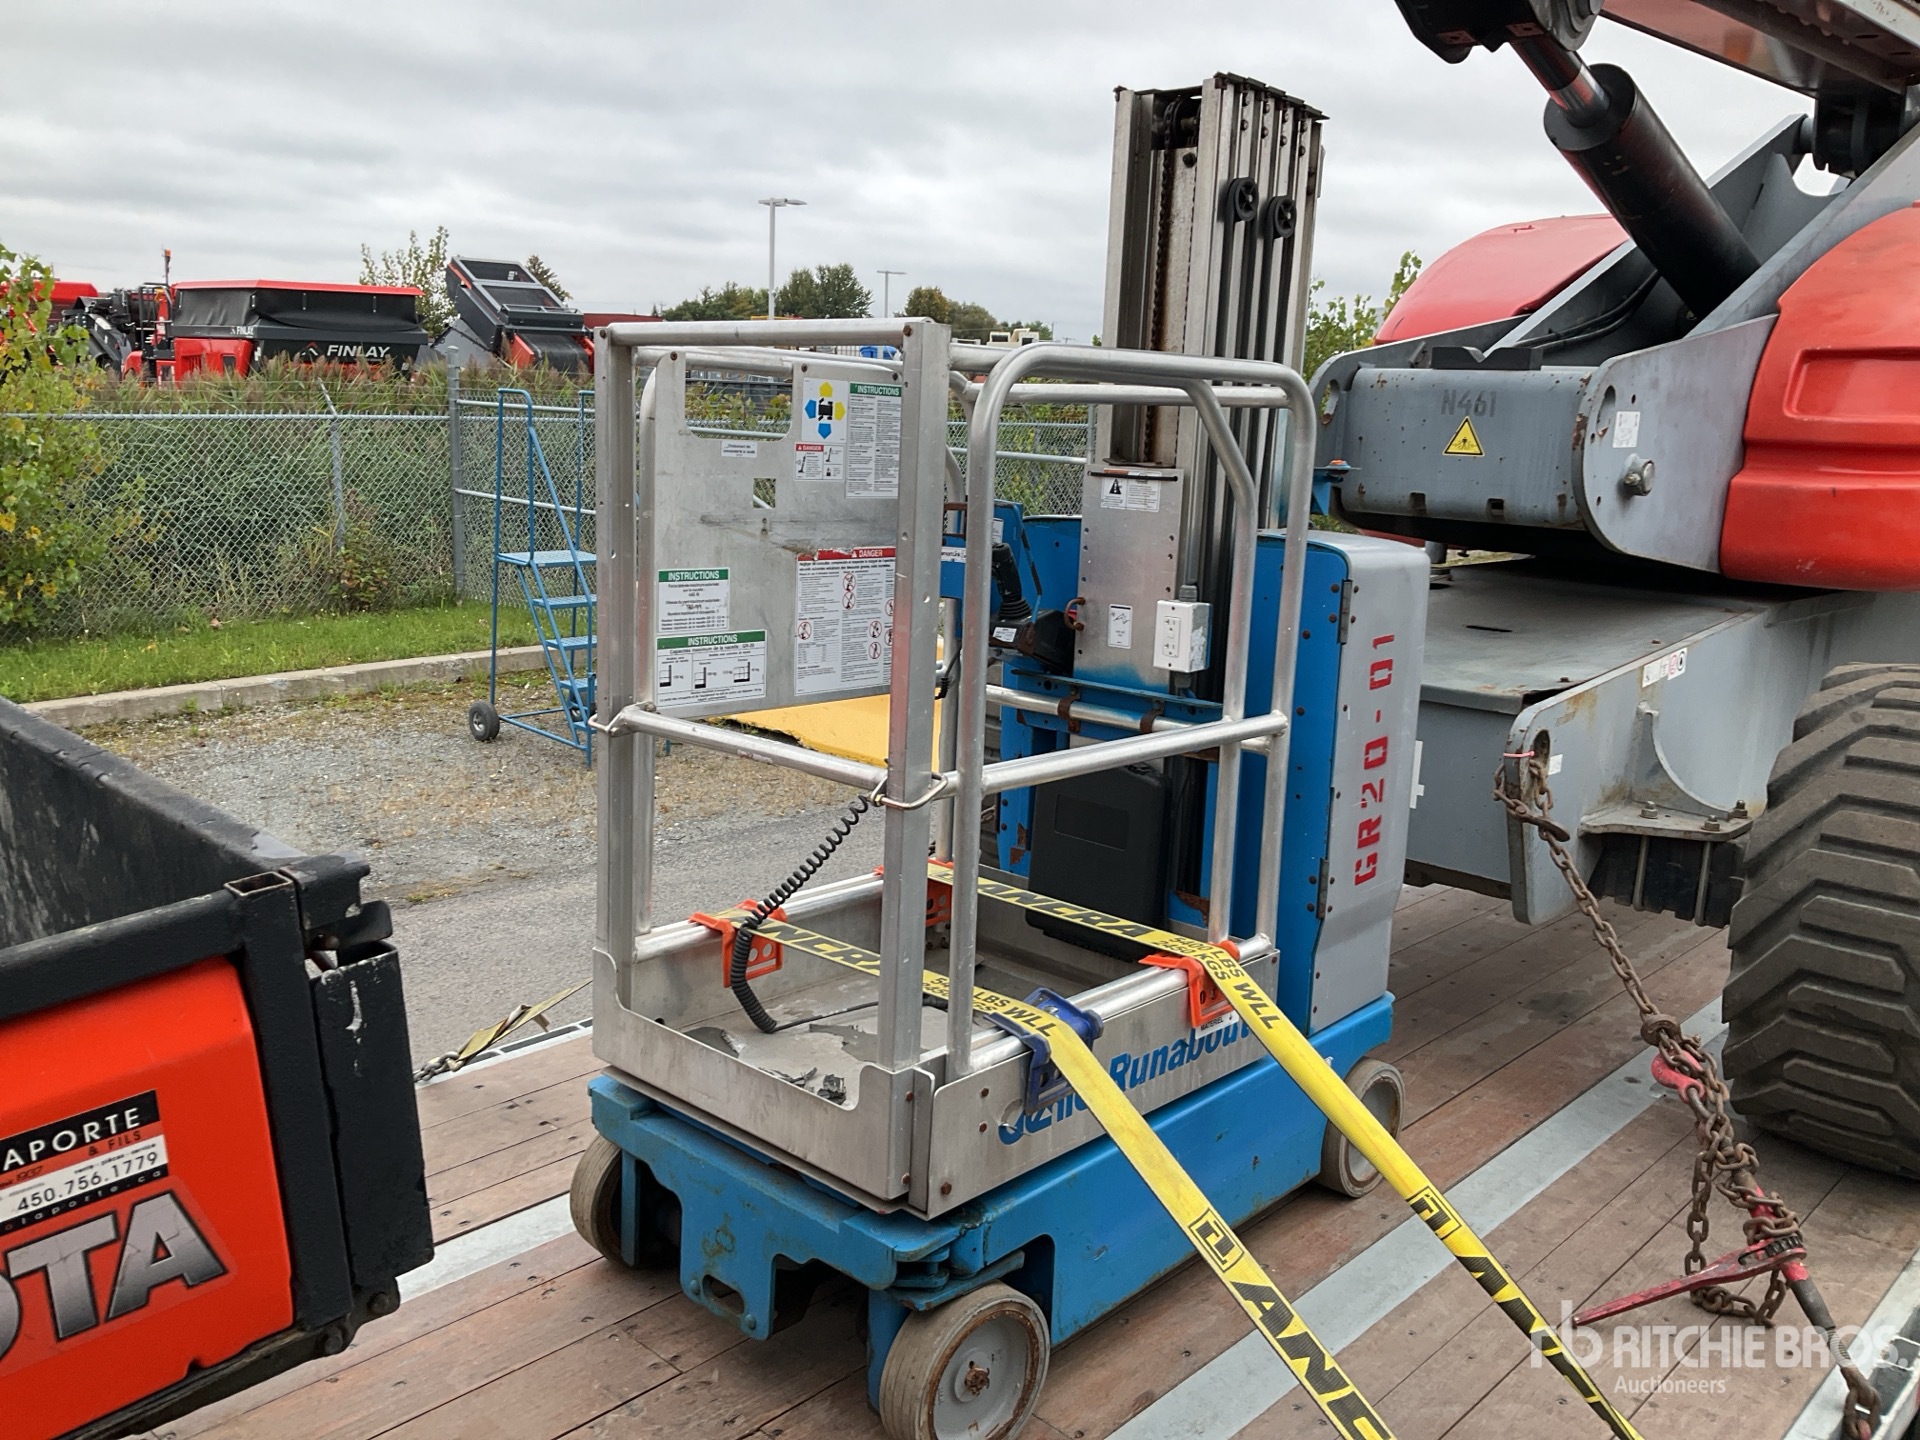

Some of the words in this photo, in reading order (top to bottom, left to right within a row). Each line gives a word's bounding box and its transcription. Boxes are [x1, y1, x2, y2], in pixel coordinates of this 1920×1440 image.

[327, 345, 390, 358] FINLAY
[857, 385, 900, 396] INSTRUCTIONS
[858, 549, 883, 558] DANGER
[667, 570, 720, 581] INSTRUCTIONS
[687, 634, 738, 647] INSTRUCTIONS
[1354, 633, 1395, 886] GR20-01
[1196, 952, 1231, 980] KGS
[1211, 949, 1245, 978] LBS
[1233, 982, 1281, 1030] WLL
[973, 990, 1011, 1008] LBS
[1002, 1006, 1057, 1037] WLL
[107, 1130, 142, 1150] FILS
[18, 1151, 158, 1211] 450.756.1779
